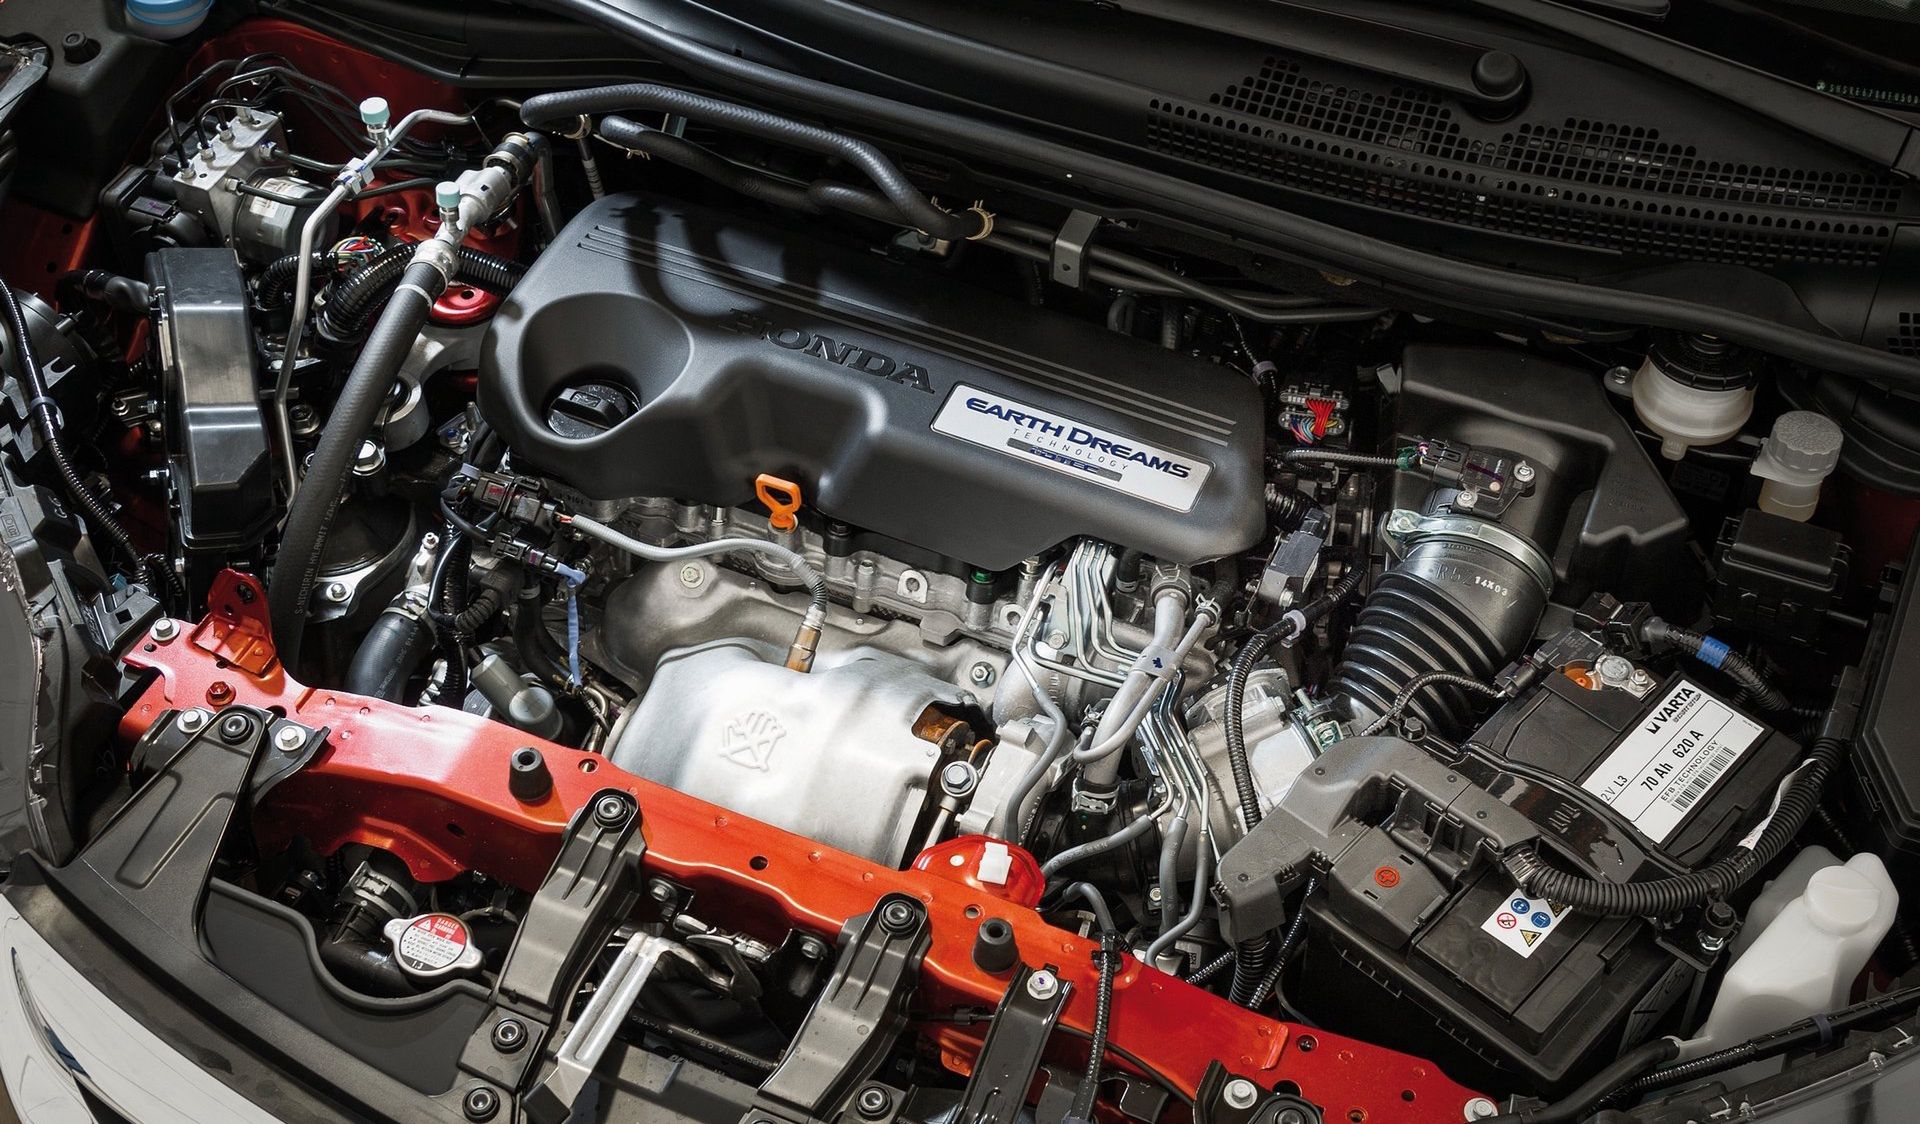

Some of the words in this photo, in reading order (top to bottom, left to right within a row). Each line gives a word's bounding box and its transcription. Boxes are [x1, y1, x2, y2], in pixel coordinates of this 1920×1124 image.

[718, 308, 935, 394] HONDA
[966, 397, 1064, 438] EARTH
[1067, 426, 1191, 479] DREAMS
[1013, 428, 1129, 471] TECHNOLOGY
[1654, 687, 1695, 724] VARTA
[1600, 786, 1616, 802] 2V
[1613, 775, 1628, 788] L3
[1641, 776, 1659, 791] 70
[1654, 761, 1674, 779] Ah
[1672, 738, 1695, 759] 620
[1690, 729, 1704, 741] A
[1661, 786, 1676, 802] EFB
[1674, 740, 1719, 787] TECHNOLOGY
